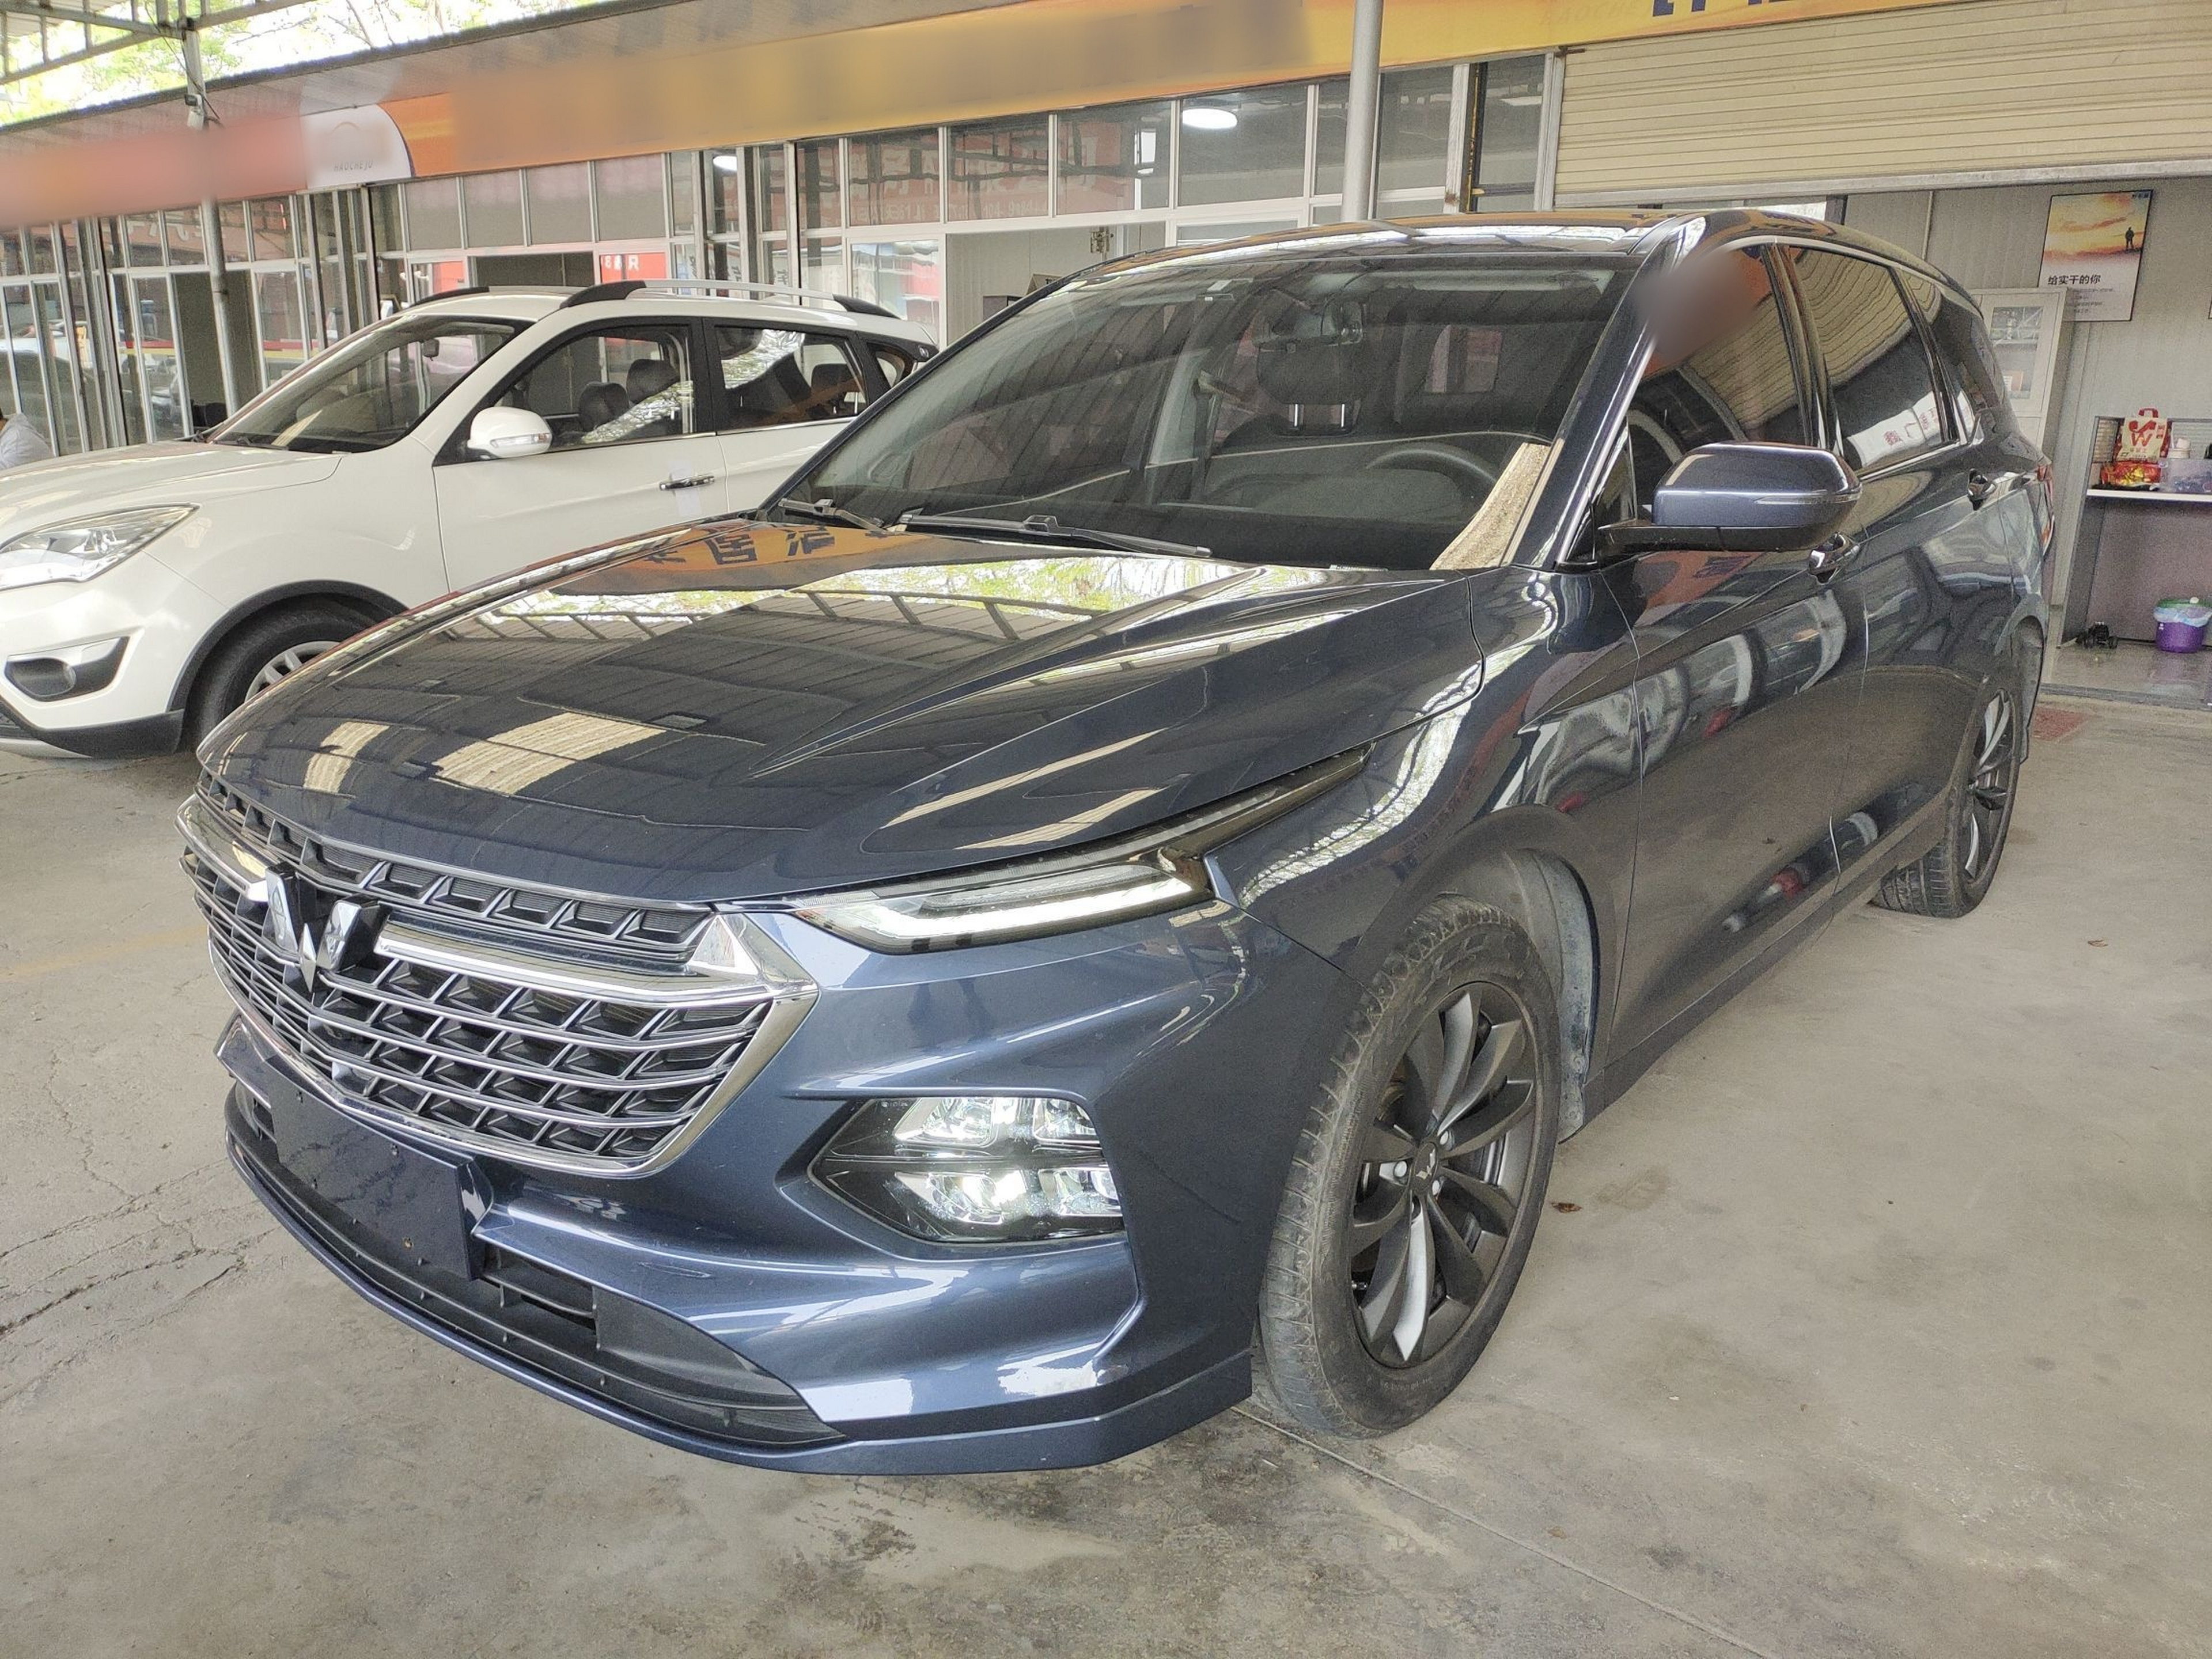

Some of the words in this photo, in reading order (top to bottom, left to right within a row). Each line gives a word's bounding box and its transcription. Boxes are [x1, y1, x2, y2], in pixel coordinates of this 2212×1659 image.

[334, 160, 373, 172] HAOCHEJU
[2047, 274, 2101, 285] 给实干的你
